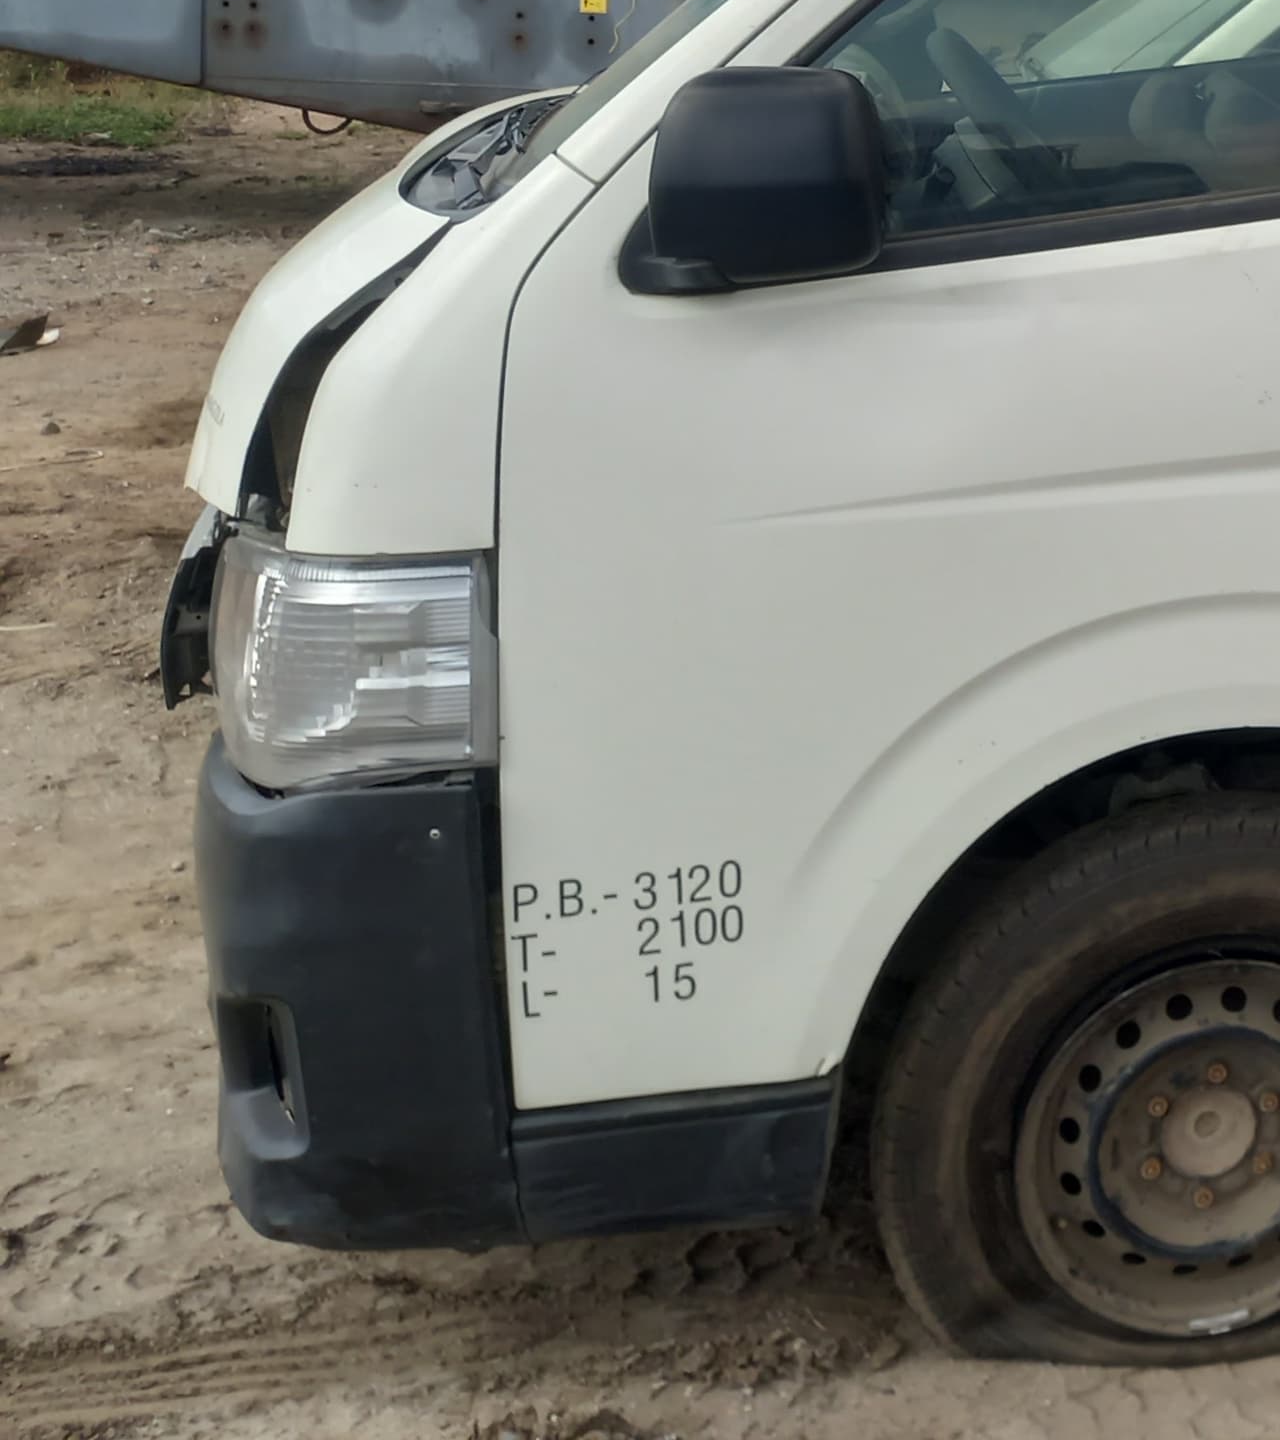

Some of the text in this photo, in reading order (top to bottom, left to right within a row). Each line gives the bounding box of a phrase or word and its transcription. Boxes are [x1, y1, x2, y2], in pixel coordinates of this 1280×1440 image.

[632, 859, 742, 911] 3120
[636, 904, 745, 956] 2100
[644, 961, 697, 1003] 15
